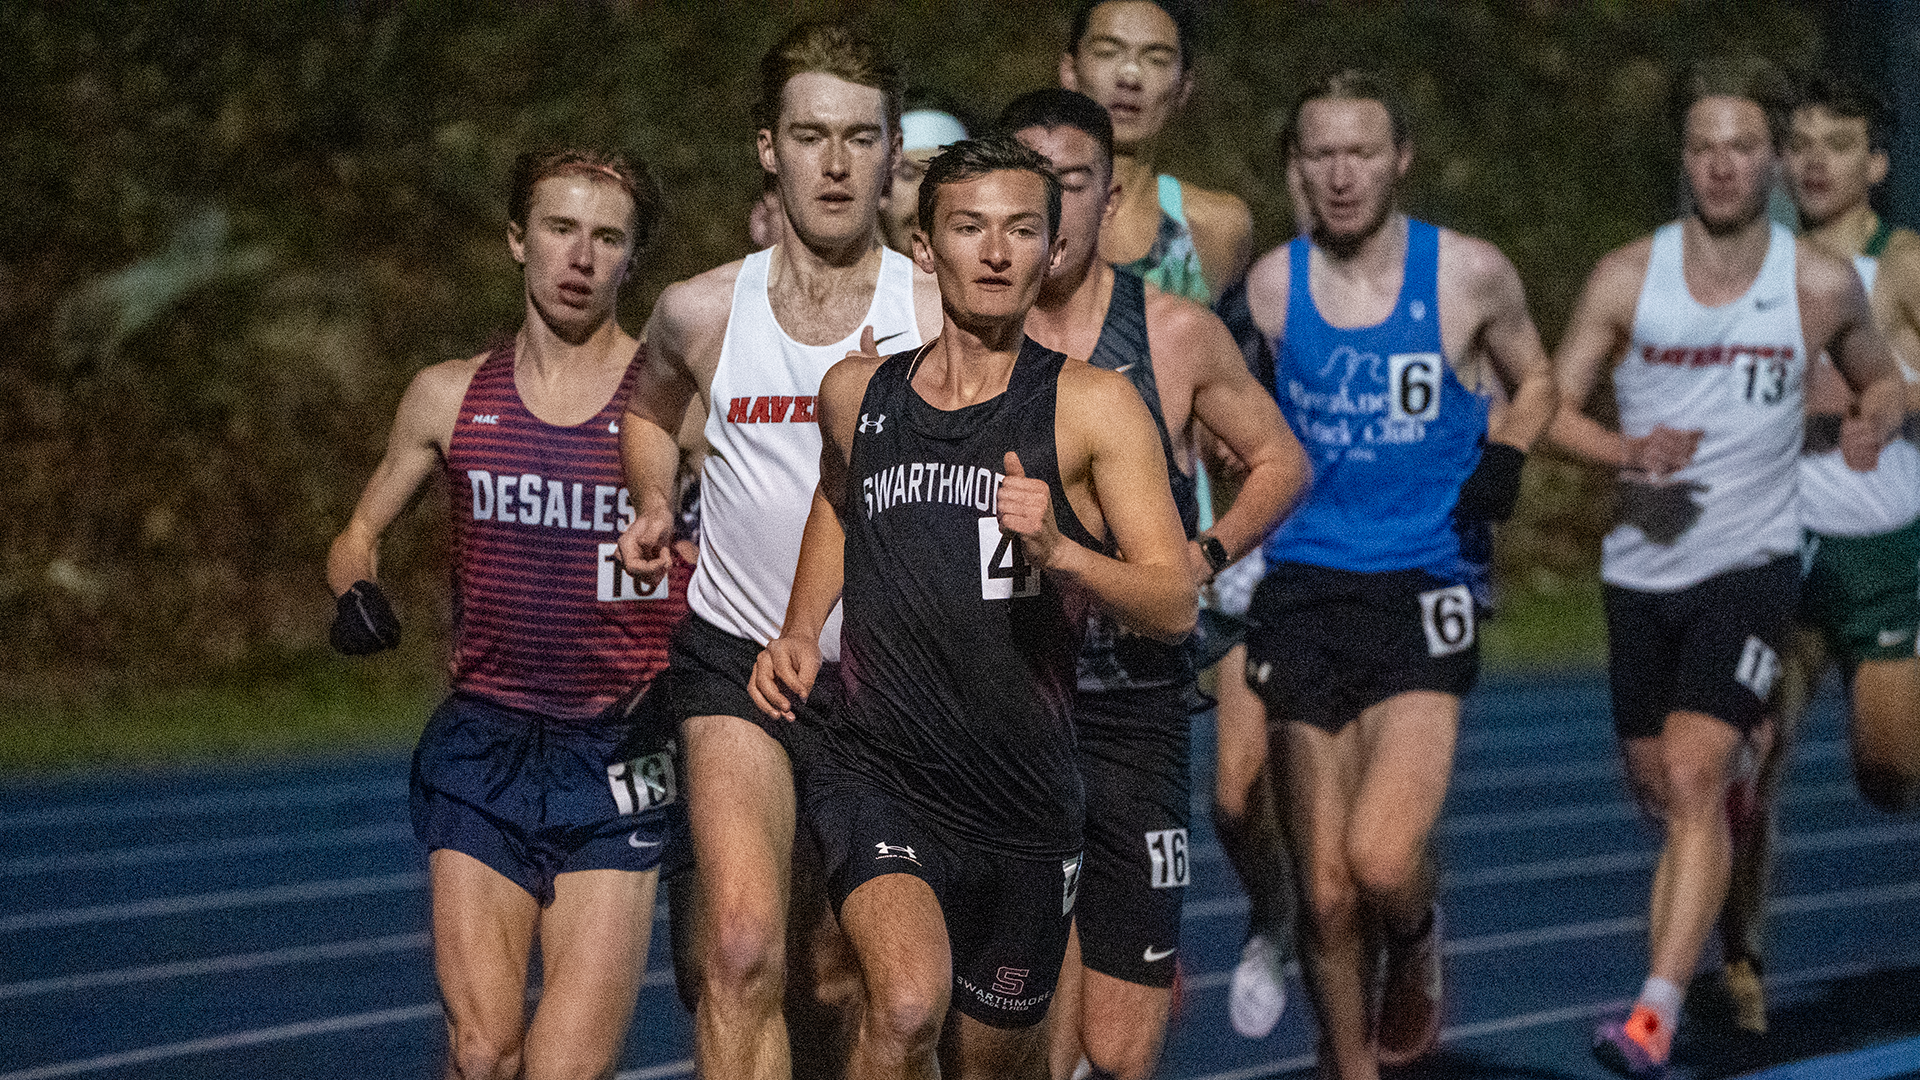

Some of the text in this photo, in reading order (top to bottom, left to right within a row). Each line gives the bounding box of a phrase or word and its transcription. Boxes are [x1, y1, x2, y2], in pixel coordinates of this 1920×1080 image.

[1401, 362, 1432, 416] 6
[1744, 359, 1787, 404] 13
[471, 415, 499, 425] MAC
[727, 395, 818, 423] HAVE
[987, 532, 1032, 593] 4
[1432, 594, 1466, 645] 6
[1151, 832, 1187, 883] 16
[957, 975, 1051, 1007] SWARTHMORE
[991, 965, 1030, 996] S
